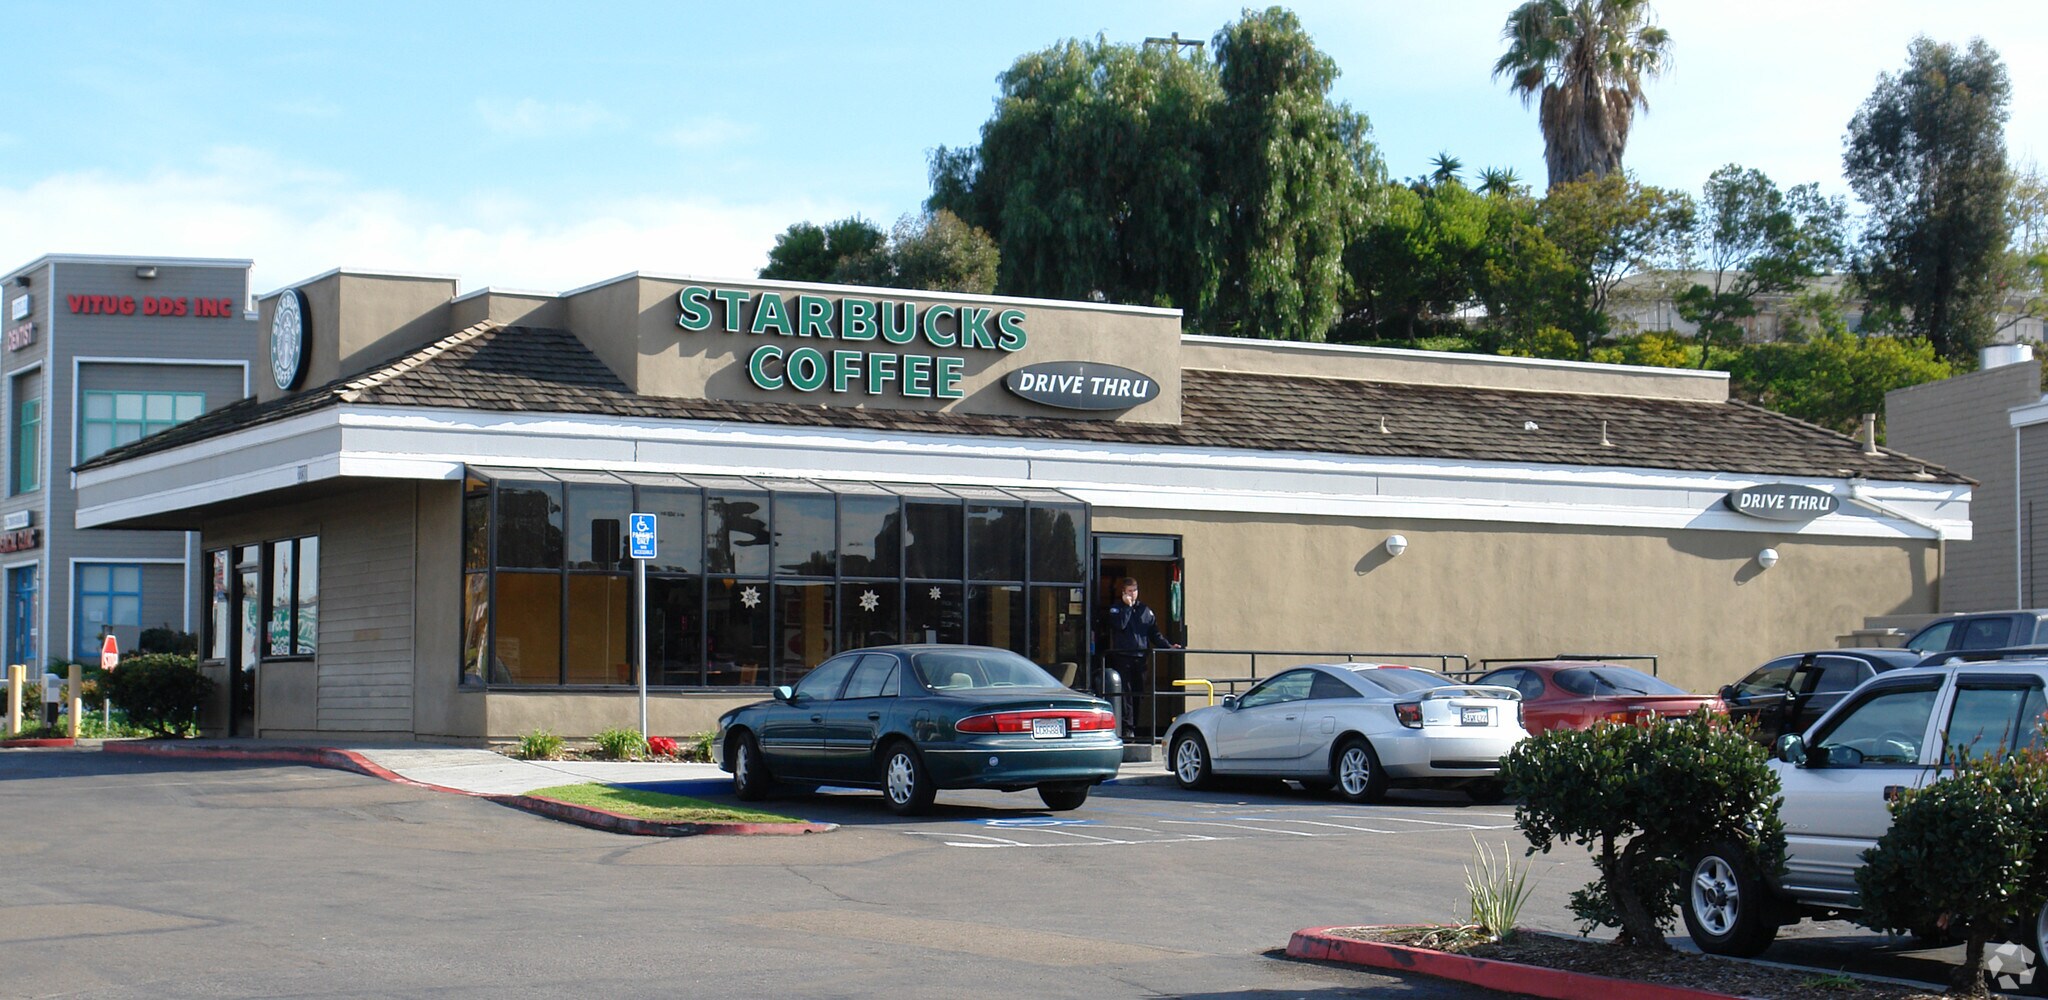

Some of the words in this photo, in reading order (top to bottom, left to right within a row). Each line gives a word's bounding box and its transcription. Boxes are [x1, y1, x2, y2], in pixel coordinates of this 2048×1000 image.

[67, 294, 136, 315] VITUG
[143, 296, 188, 317] DDS
[194, 297, 233, 318] INC
[679, 285, 1028, 352] STARBUCKS
[8, 322, 33, 351] DENTIST
[275, 359, 295, 384] COFFEE
[748, 344, 965, 399] COFFEE
[1019, 373, 1085, 394] DRIVE
[1091, 377, 1149, 398] THRU
[1740, 493, 1785, 509] DRIVE
[1789, 495, 1831, 511] THRU
